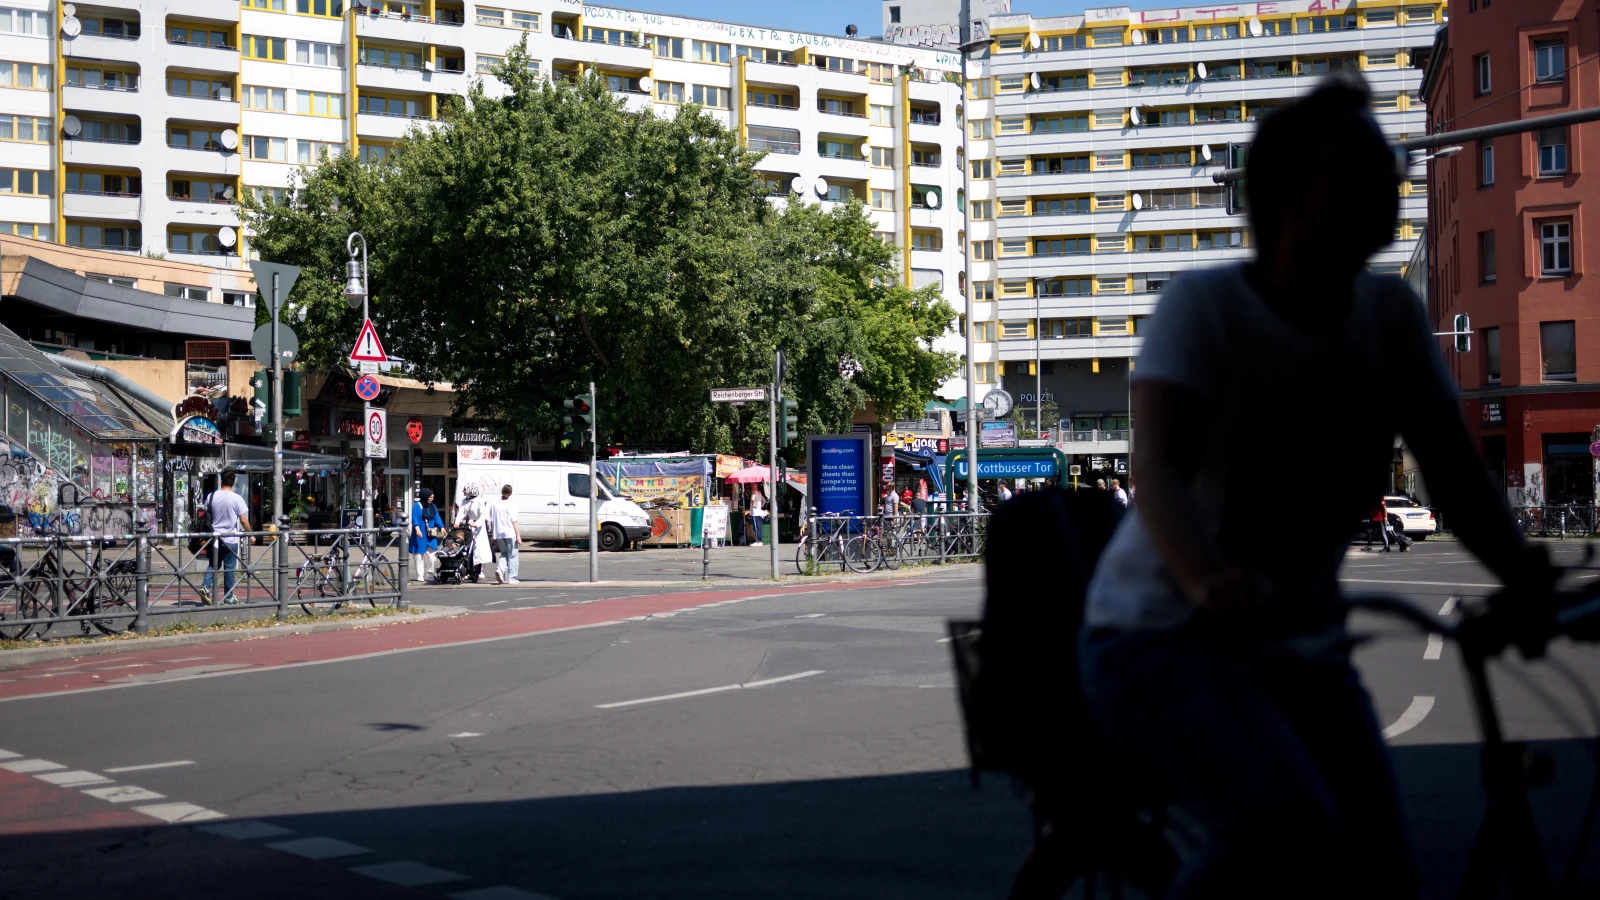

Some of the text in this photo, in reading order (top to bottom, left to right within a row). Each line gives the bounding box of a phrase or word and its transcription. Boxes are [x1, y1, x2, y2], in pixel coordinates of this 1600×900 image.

[713, 391, 753, 399] Reichenberger
[1020, 393, 1054, 402] POLZEI
[372, 420, 380, 434] 30
[912, 438, 938, 449] KIOSK
[822, 447, 854, 455] Booking.com
[959, 462, 1052, 475] U Kottbusser Tor
